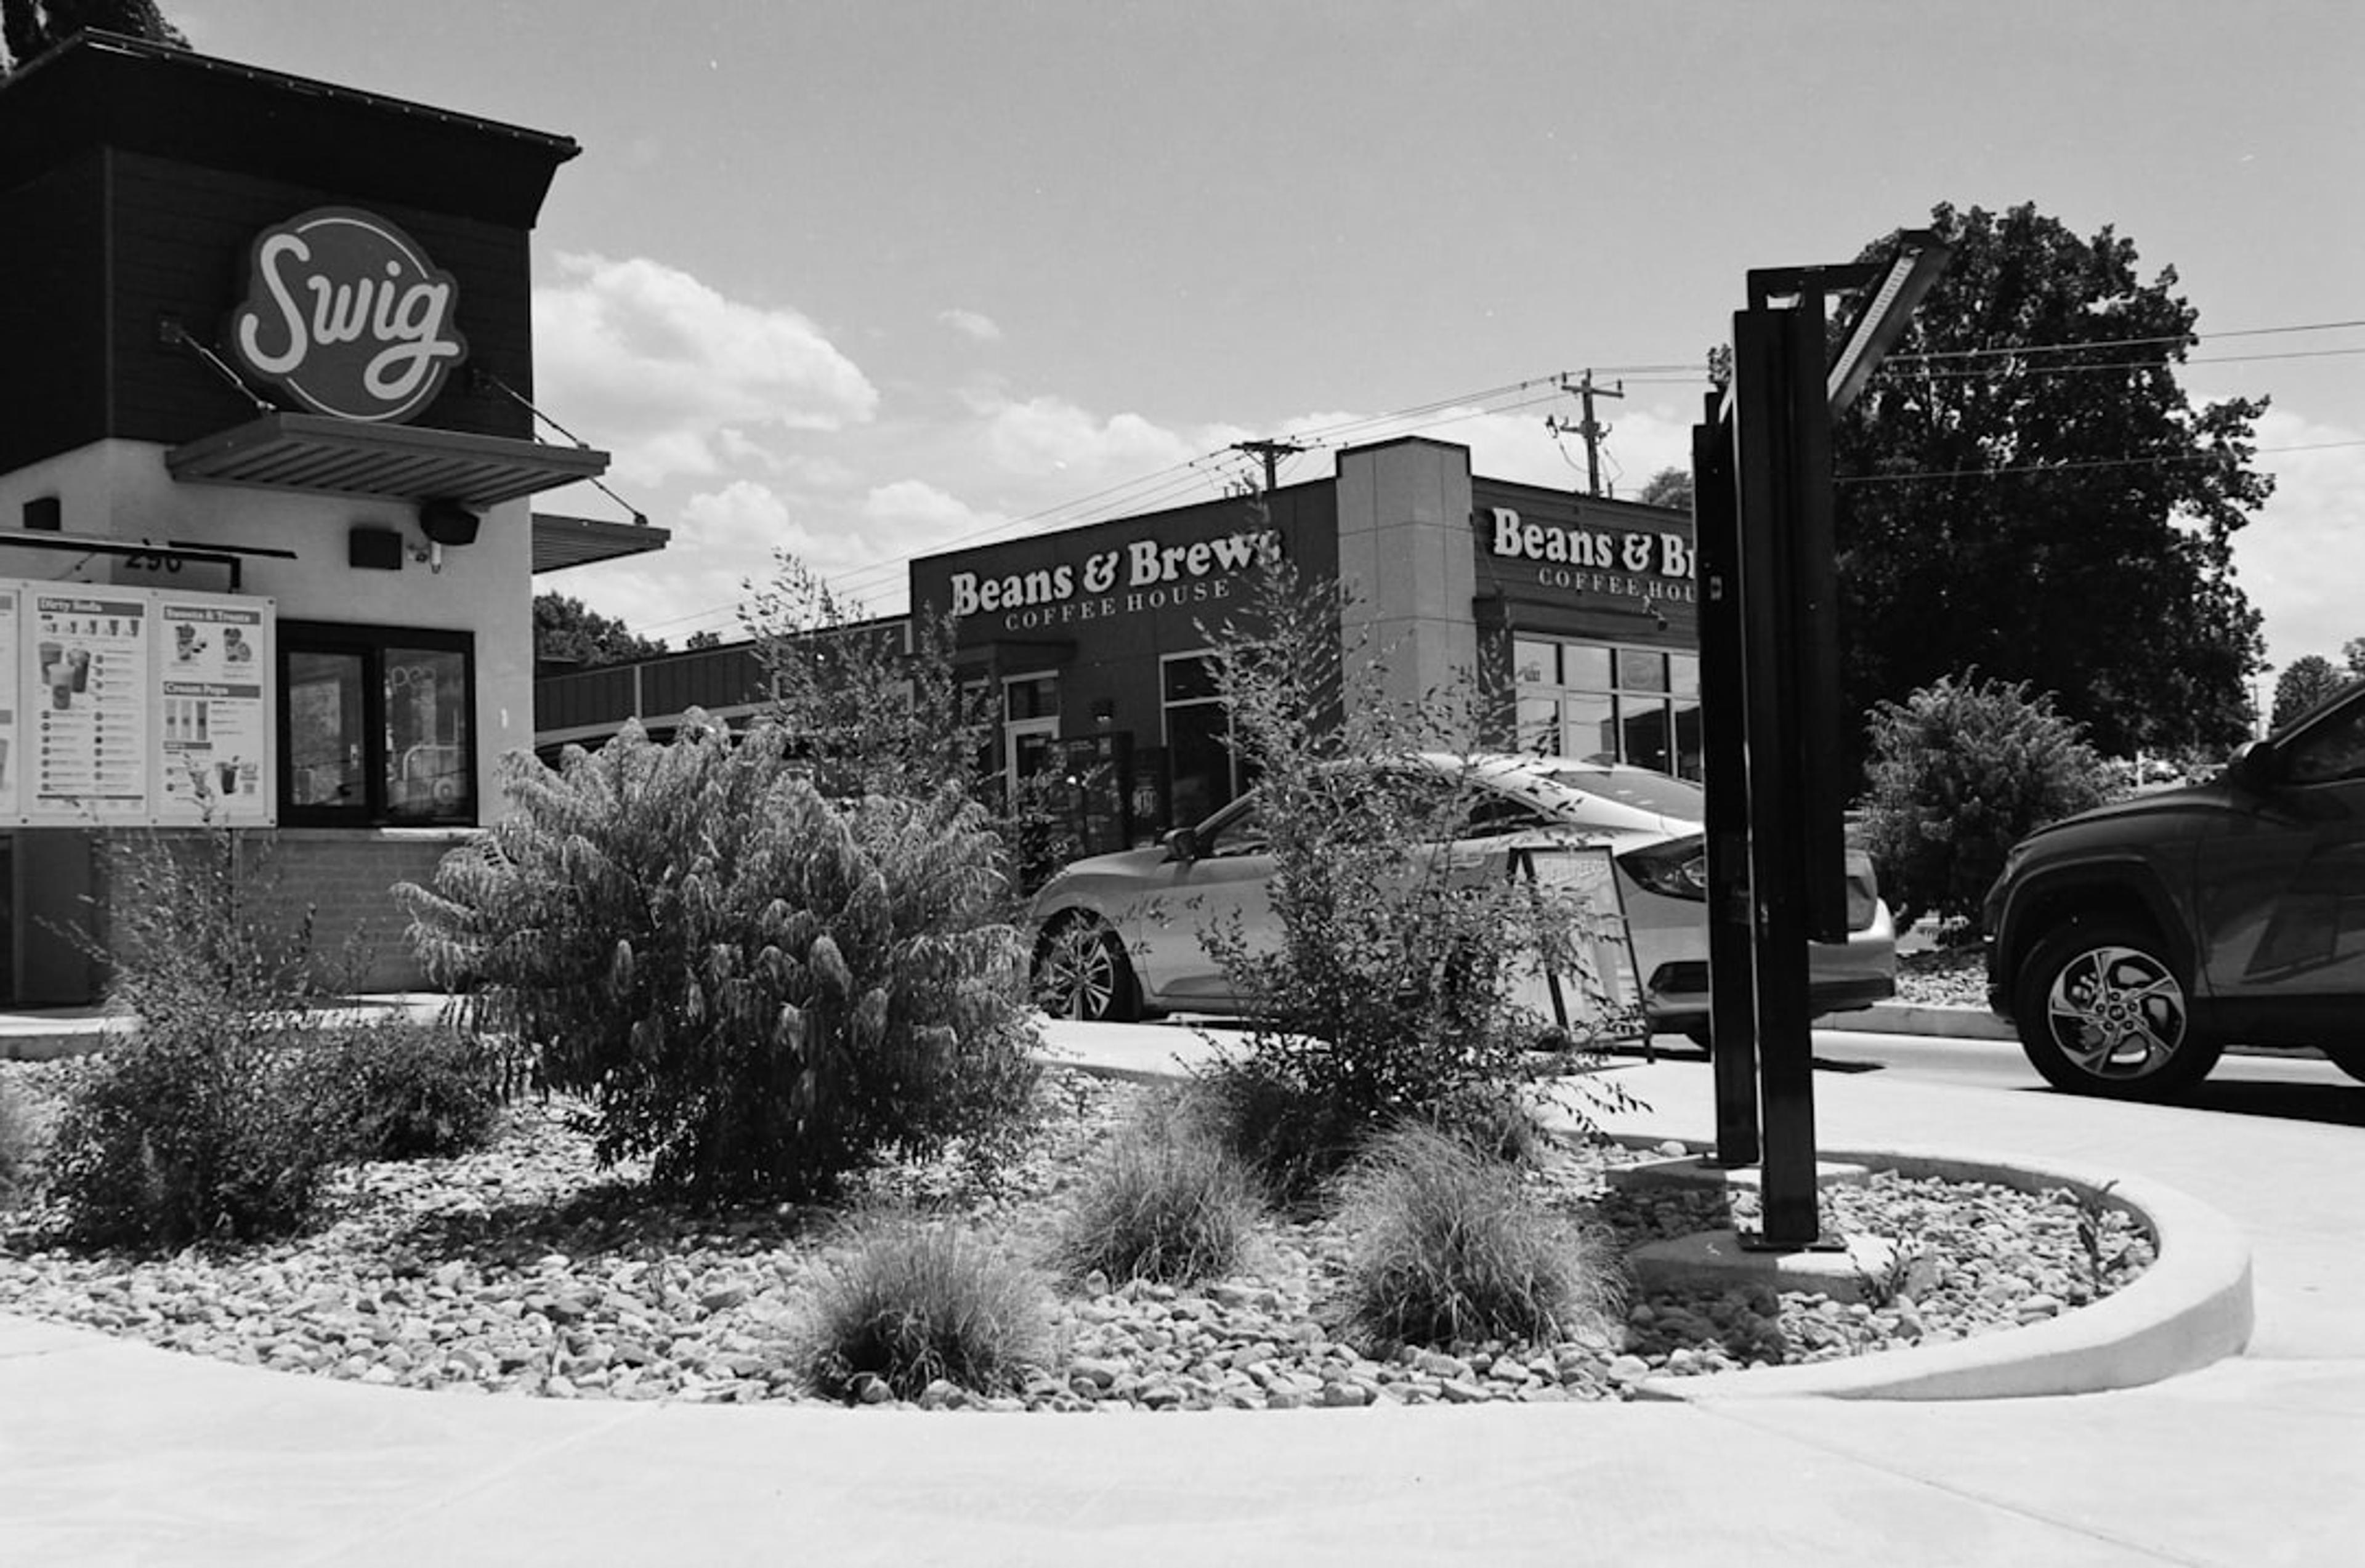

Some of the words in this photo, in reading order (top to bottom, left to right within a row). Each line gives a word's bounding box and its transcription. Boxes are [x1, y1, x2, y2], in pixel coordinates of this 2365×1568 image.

[240, 233, 459, 400] Swig
[1493, 507, 1613, 568] Beans
[1622, 532, 1652, 571] &
[951, 564, 1074, 616] Beans
[1083, 551, 1119, 592] &
[1005, 598, 1117, 631] COFFEE
[1127, 578, 1231, 611] HOUSE
[1540, 567, 1639, 597] COFFEE
